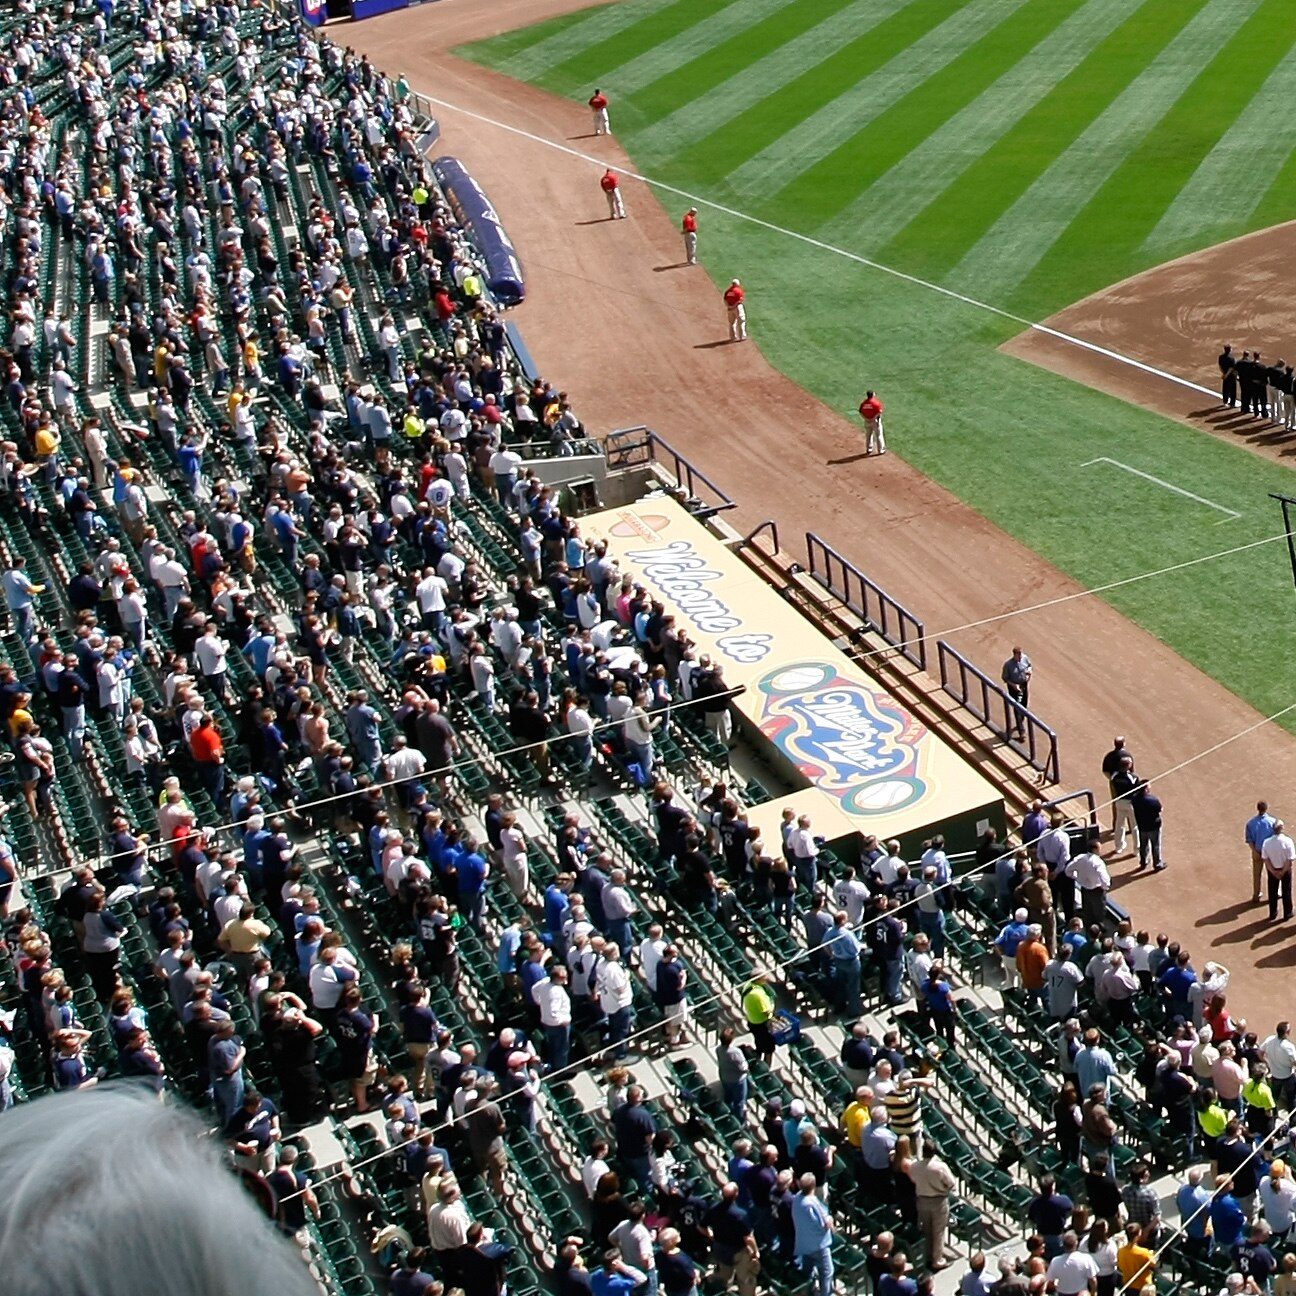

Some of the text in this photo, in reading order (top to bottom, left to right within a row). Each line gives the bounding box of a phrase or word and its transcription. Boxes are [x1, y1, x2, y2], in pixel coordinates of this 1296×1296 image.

[624, 541, 775, 664] Welcome to
[794, 692, 895, 771] Miller Park
[876, 928, 887, 943] 51
[1051, 975, 1064, 987] 17
[1240, 1257, 1249, 1272] 8
